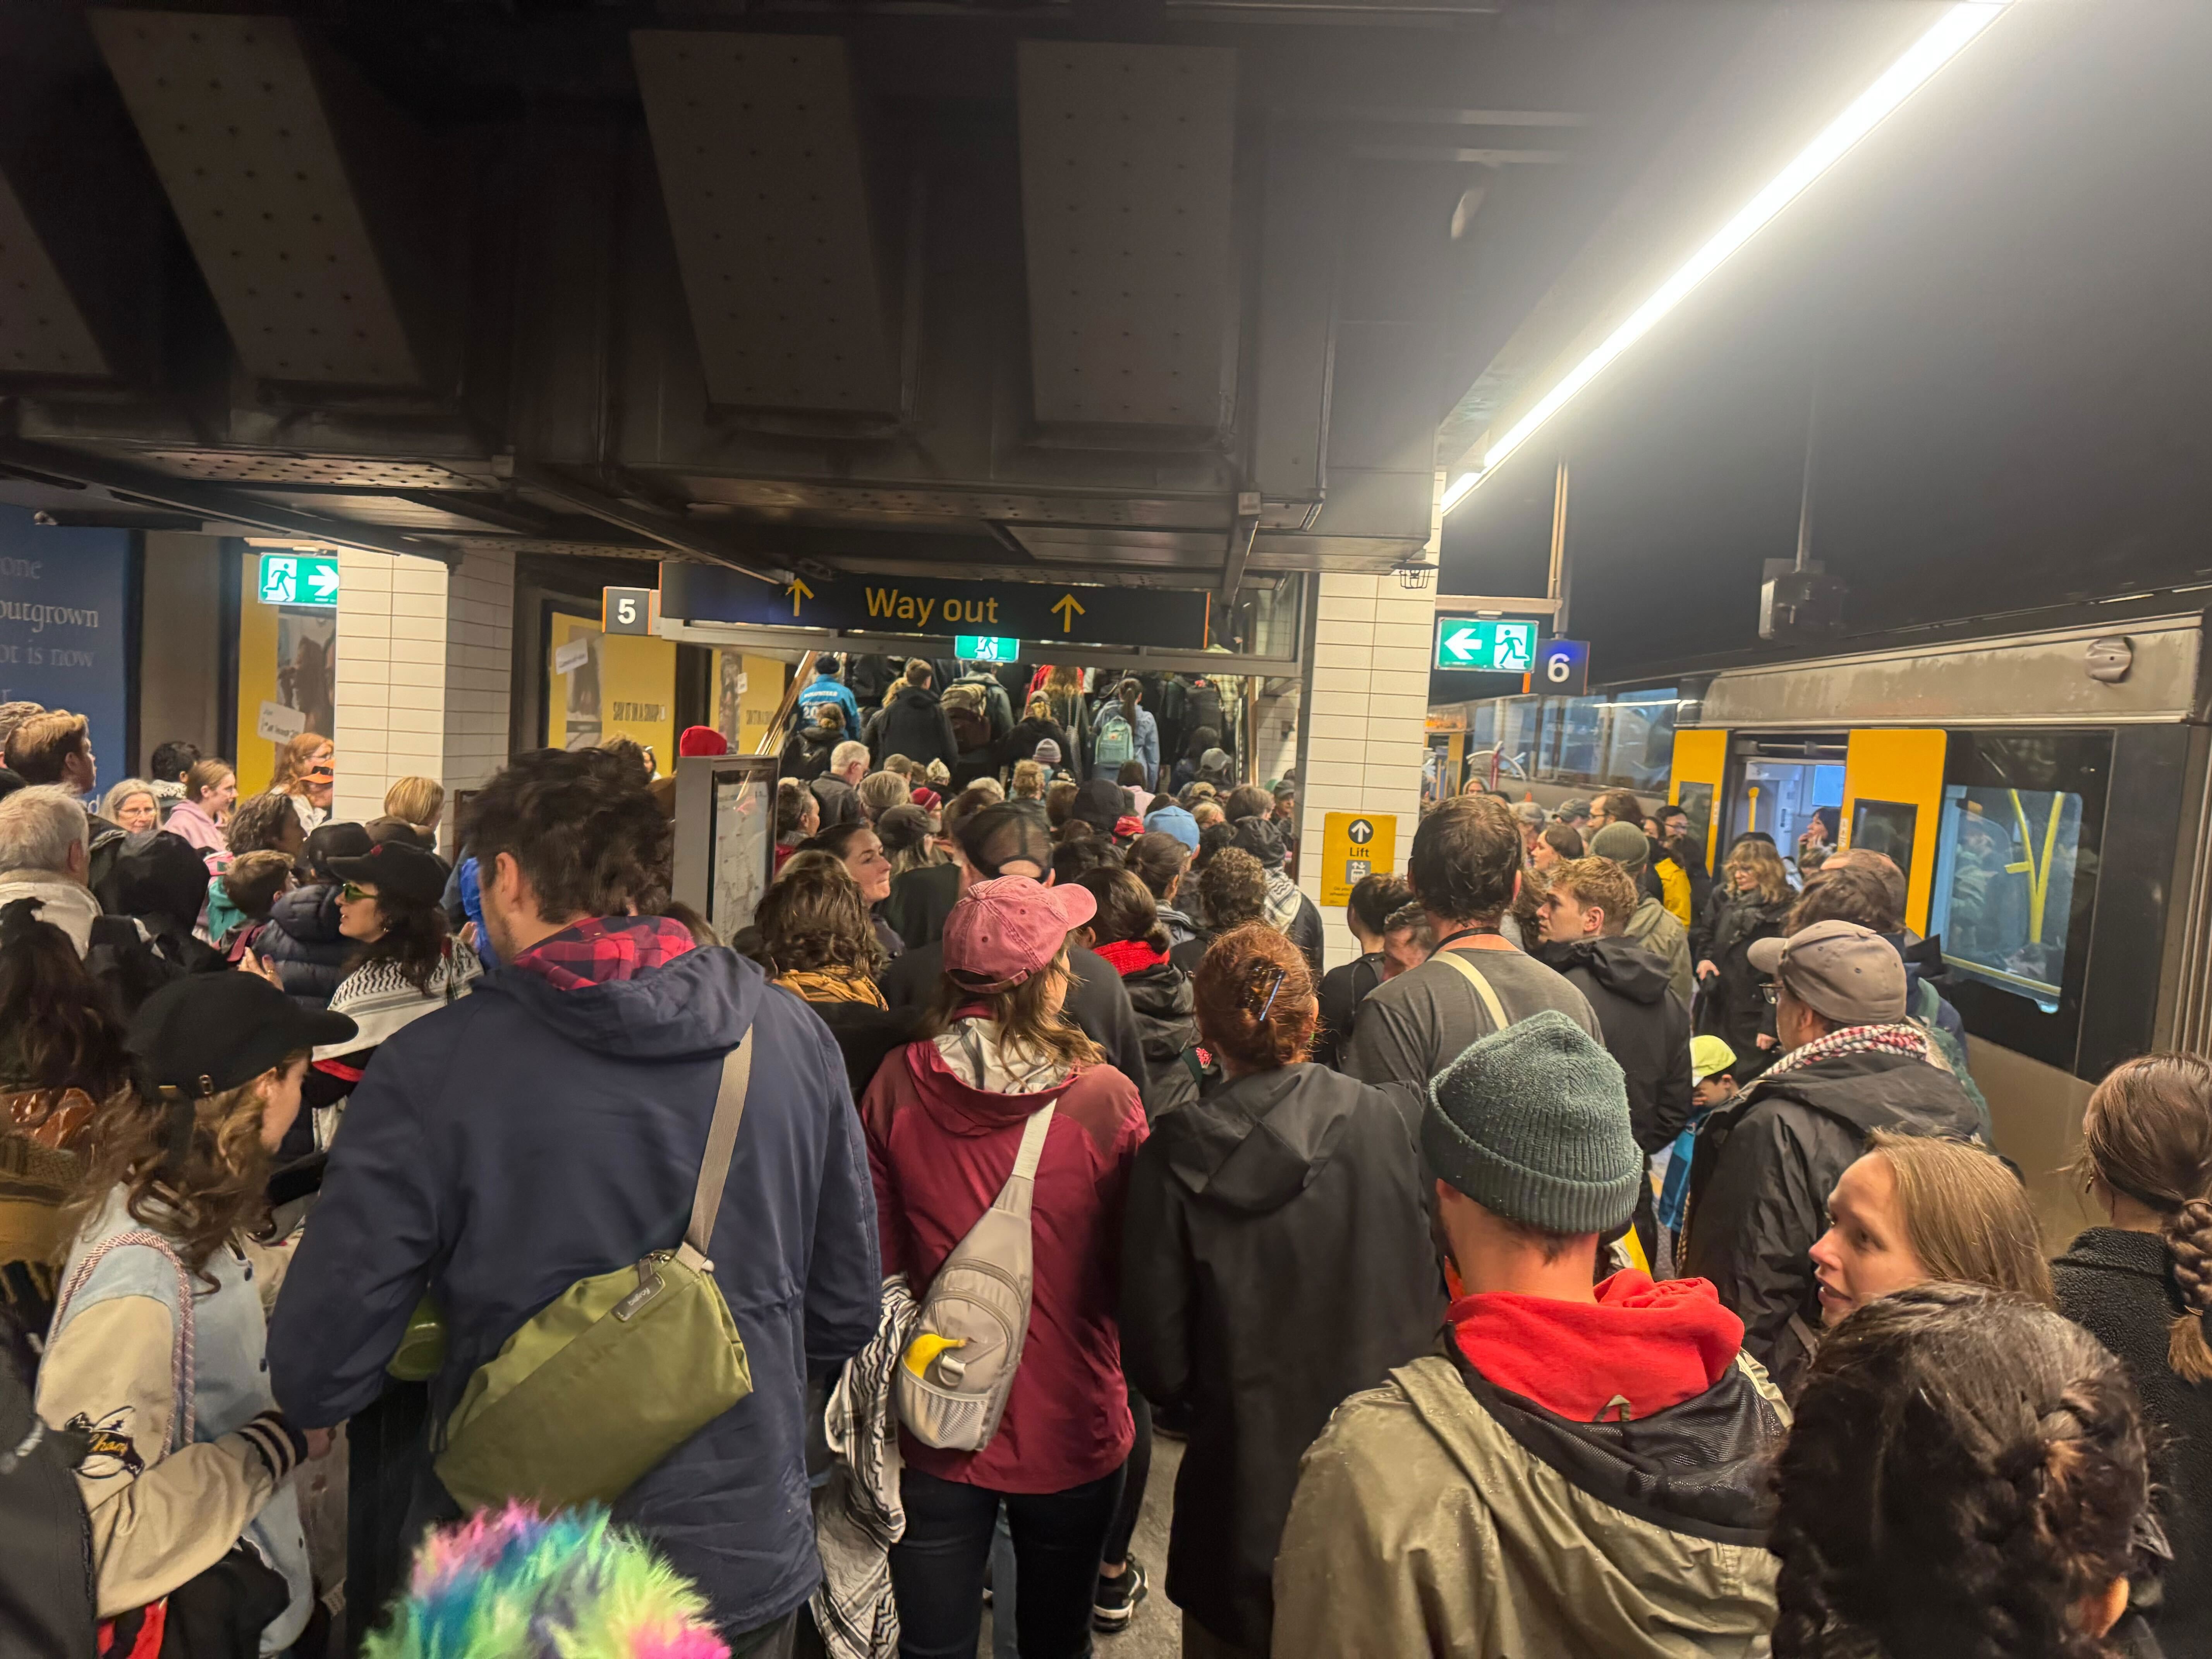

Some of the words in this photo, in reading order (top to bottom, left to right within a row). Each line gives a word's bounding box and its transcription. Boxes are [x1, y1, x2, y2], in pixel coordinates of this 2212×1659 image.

[0, 557, 42, 579] one
[618, 598, 636, 624] 5
[865, 587, 936, 628] Way
[943, 597, 998, 623] out
[27, 639, 42, 665] is
[50, 649, 95, 667] now
[1548, 653, 1570, 682] 6
[803, 706, 818, 719] 20
[1350, 847, 1369, 857] Lift
